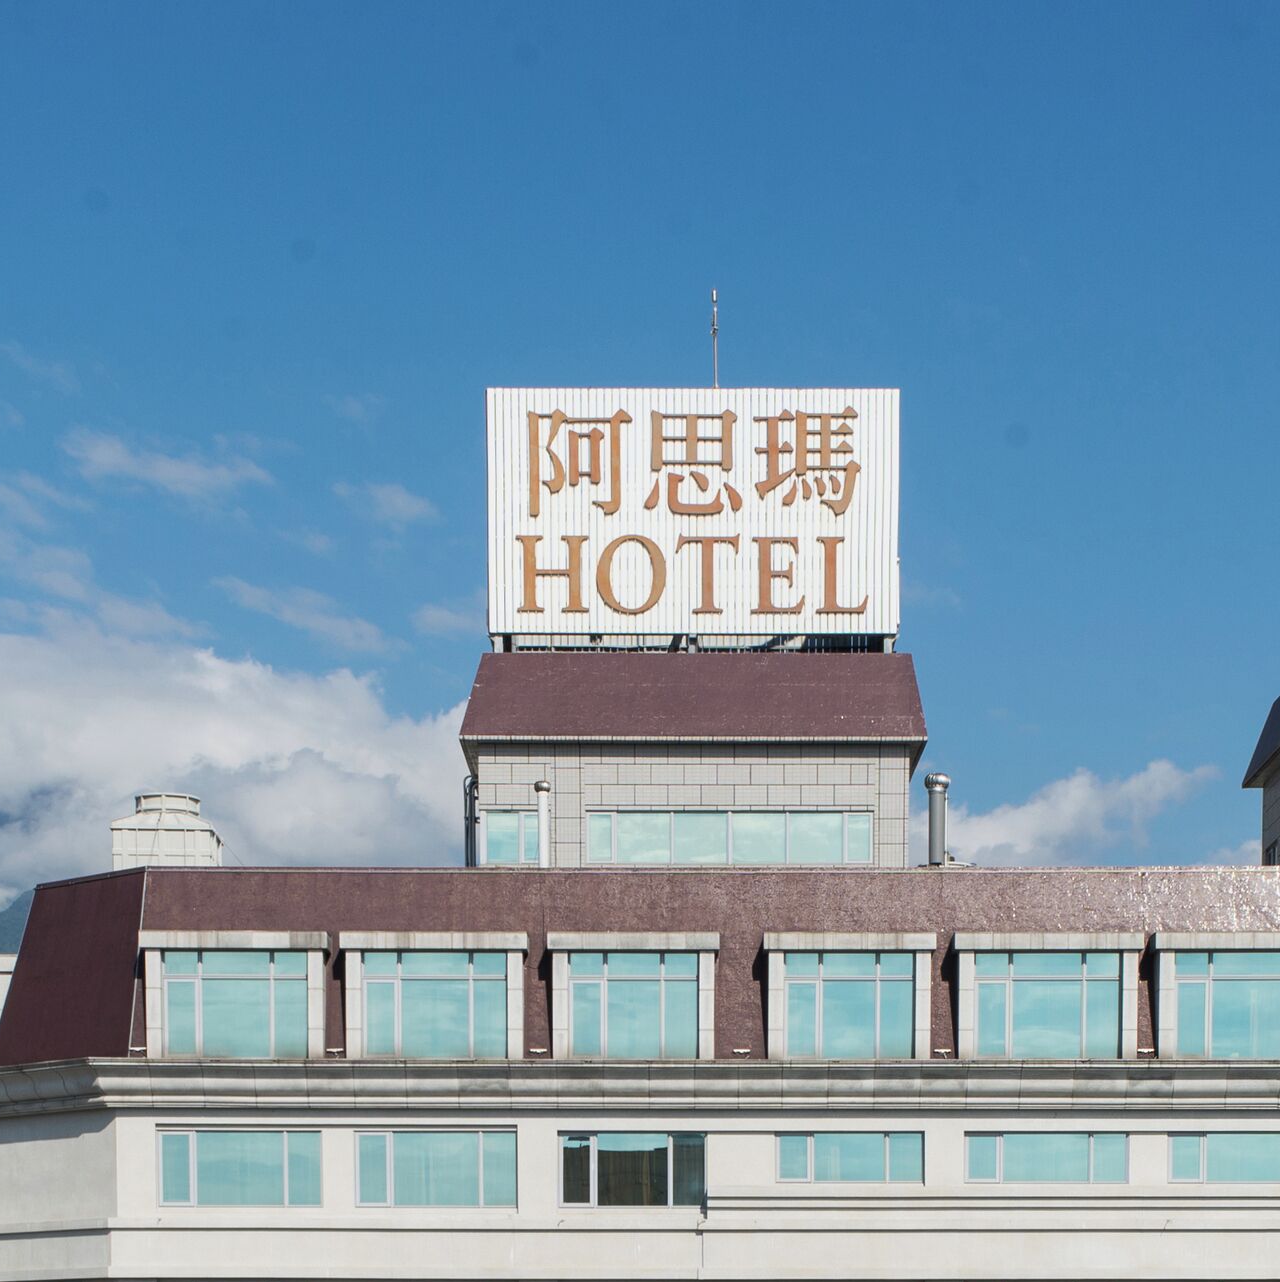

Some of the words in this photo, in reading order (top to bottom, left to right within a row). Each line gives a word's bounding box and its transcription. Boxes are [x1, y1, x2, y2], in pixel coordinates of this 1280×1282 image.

[527, 405, 862, 517] 阿思瑪
[515, 533, 869, 615] HOTEL
